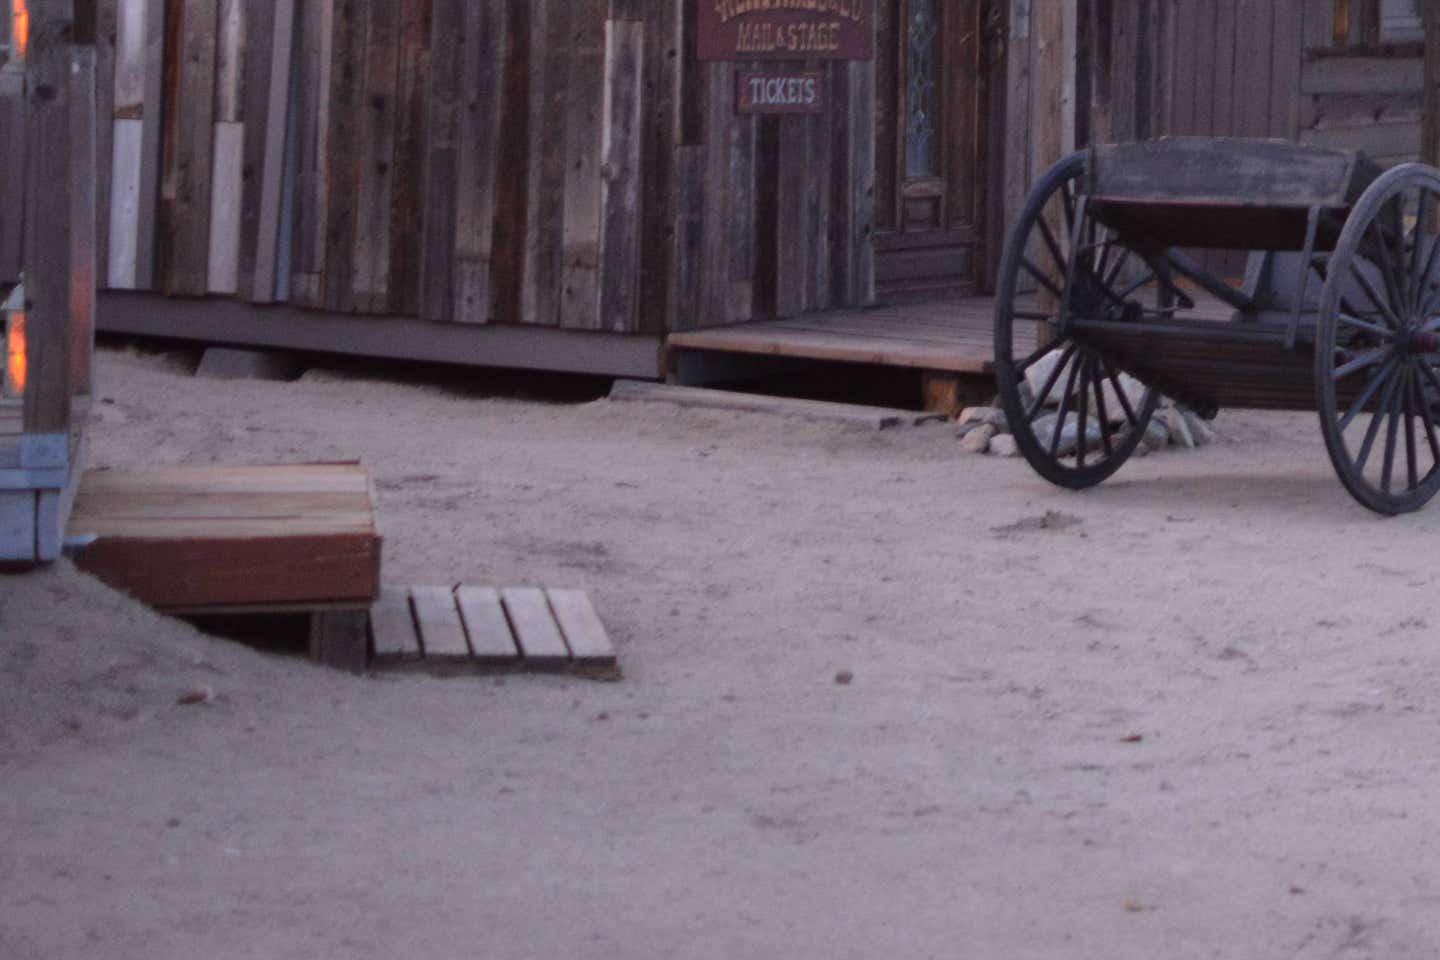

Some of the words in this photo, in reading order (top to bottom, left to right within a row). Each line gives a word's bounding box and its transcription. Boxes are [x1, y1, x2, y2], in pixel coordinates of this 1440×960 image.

[735, 23, 776, 52] MAIL
[787, 22, 841, 51] STAGE
[750, 77, 816, 105] TICKETS
